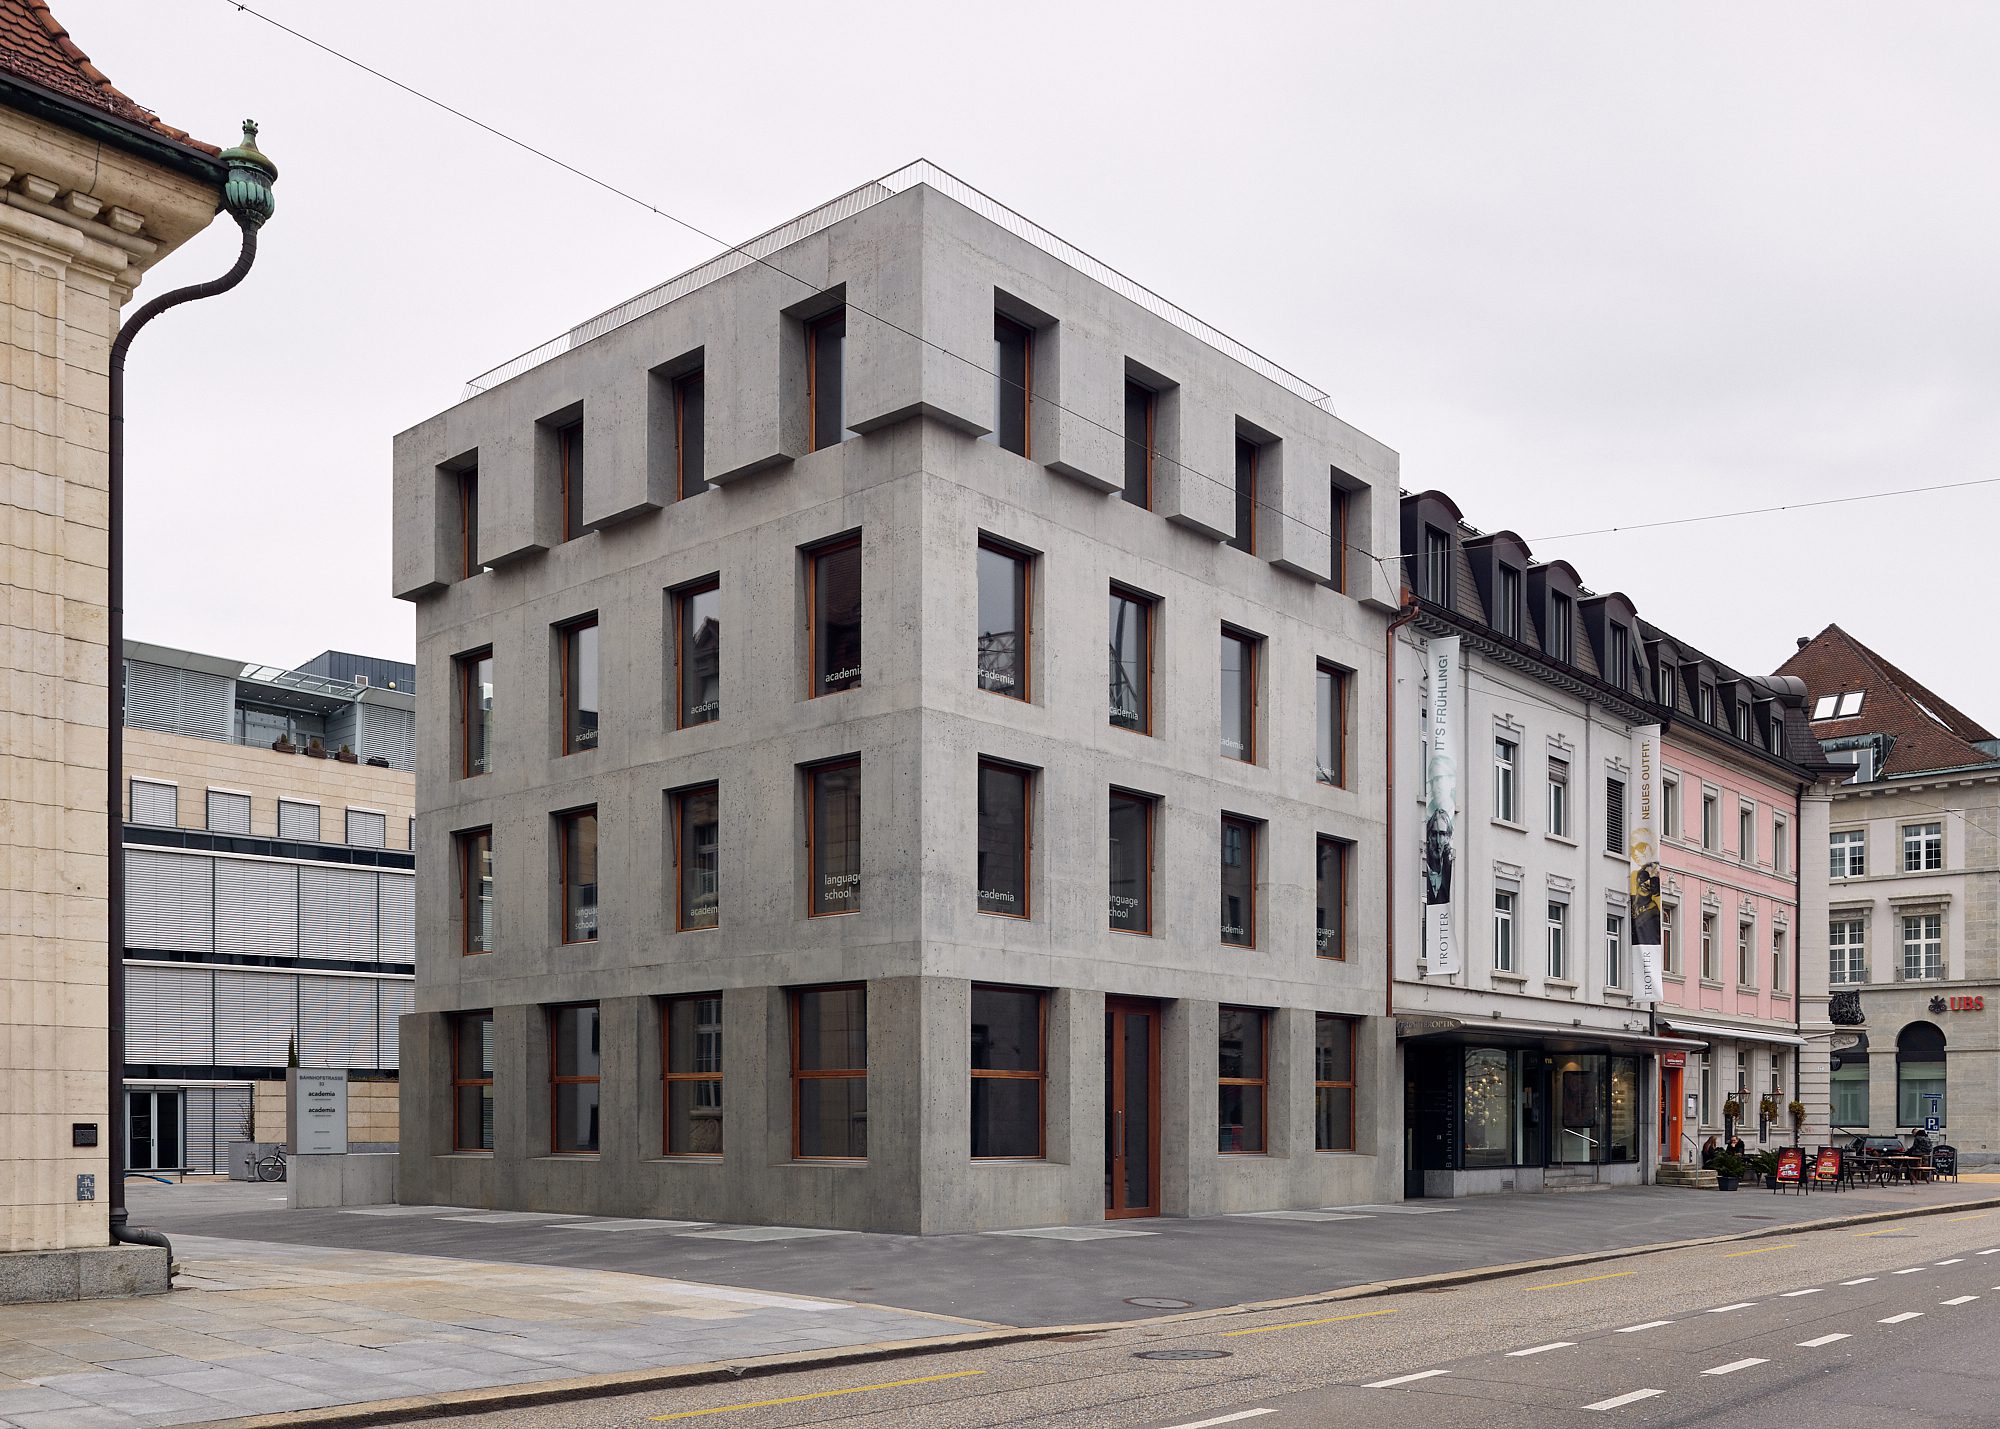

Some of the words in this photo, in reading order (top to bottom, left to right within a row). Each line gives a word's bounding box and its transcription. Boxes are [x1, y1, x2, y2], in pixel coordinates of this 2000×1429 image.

[1435, 654, 1448, 724] FRÜHLING!
[1434, 727, 1446, 751] IT'S
[1641, 739, 1650, 780] OUTFIT.
[1641, 783, 1650, 820] NEUES
[824, 886, 852, 901] school
[1439, 912, 1449, 967] TROTTER
[1643, 951, 1653, 997] TROTTER
[1950, 995, 1985, 1011] UBS
[1928, 1118, 1936, 1129] P
